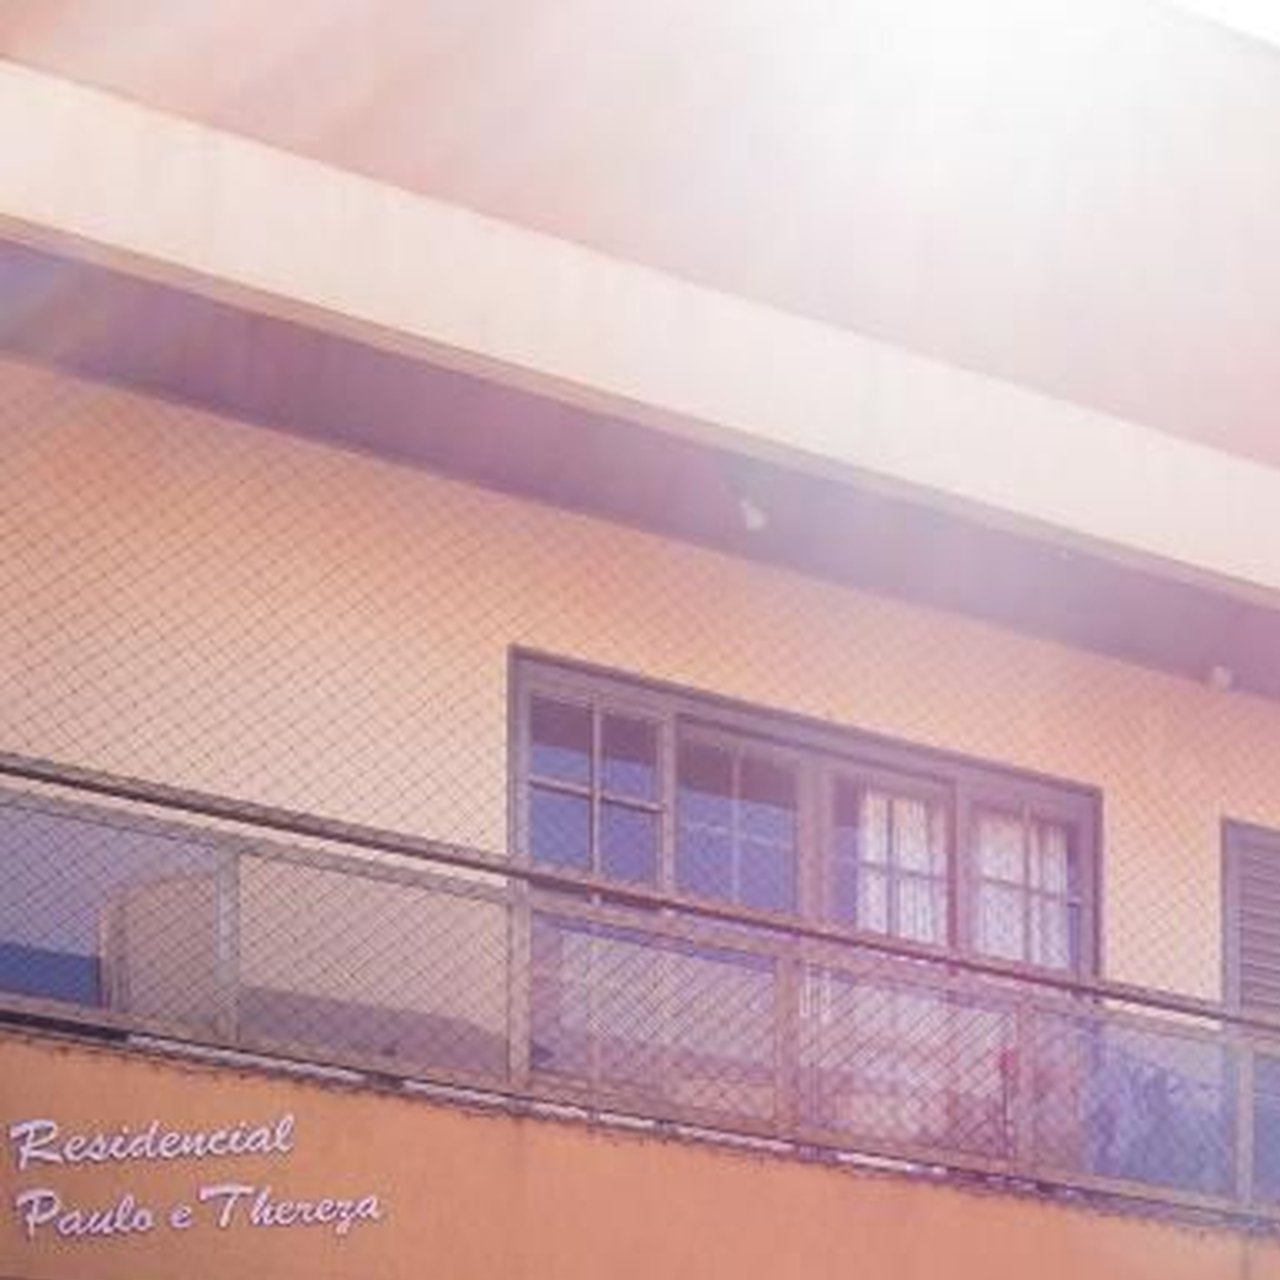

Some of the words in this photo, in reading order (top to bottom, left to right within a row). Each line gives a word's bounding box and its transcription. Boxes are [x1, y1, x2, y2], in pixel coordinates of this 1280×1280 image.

[10, 1114, 295, 1169] Residencial
[15, 1188, 155, 1237] Paulo
[169, 1205, 192, 1228] e
[199, 1183, 384, 1234] Thereza
